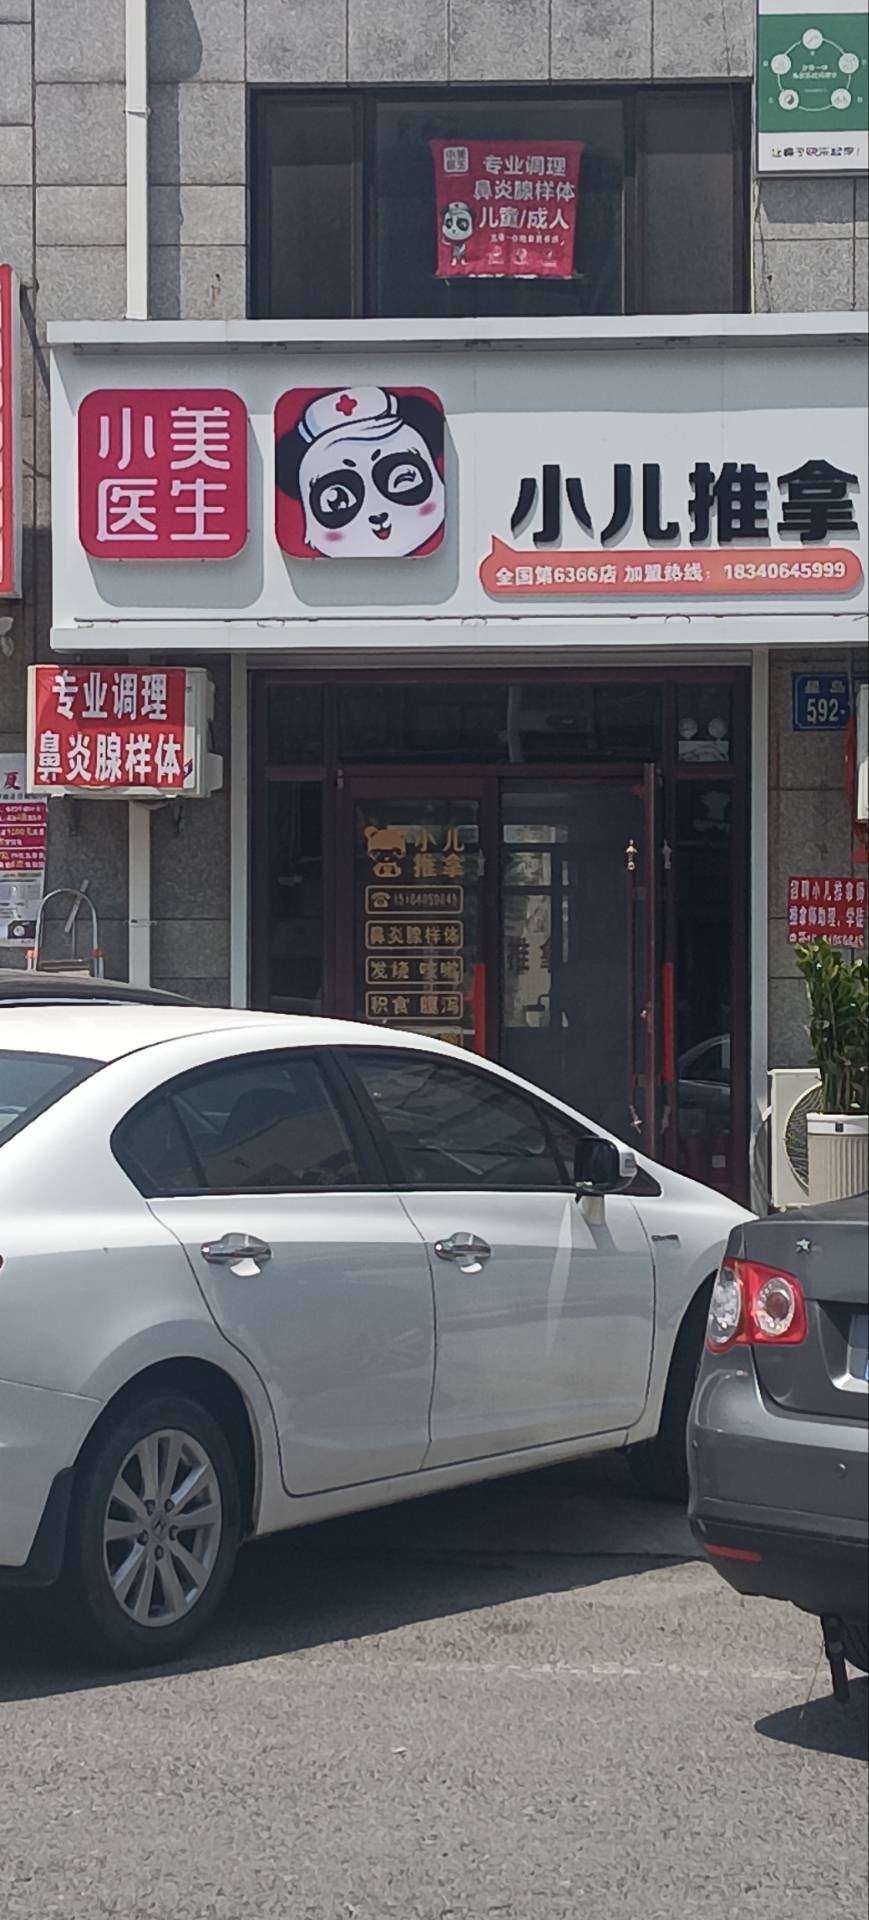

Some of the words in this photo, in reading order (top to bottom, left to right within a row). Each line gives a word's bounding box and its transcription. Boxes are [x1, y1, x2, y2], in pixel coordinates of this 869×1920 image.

[483, 155, 566, 177] 专业调理
[474, 179, 575, 202] 鼻炎腺样体
[479, 207, 568, 230] 儿童/成人
[98, 406, 230, 470] 小美
[96, 478, 230, 542] 医生
[510, 459, 860, 548] 小儿推拿
[495, 563, 617, 586] 全国第6366店
[724, 562, 845, 581] 18340645999
[52, 670, 168, 720] 专业调理
[37, 730, 183, 784] 鼻炎腺样体
[414, 828, 465, 851] 小儿
[413, 854, 465, 878] 推拿
[370, 926, 459, 945] 鼻炎腺样体
[371, 996, 410, 1015] 积食
